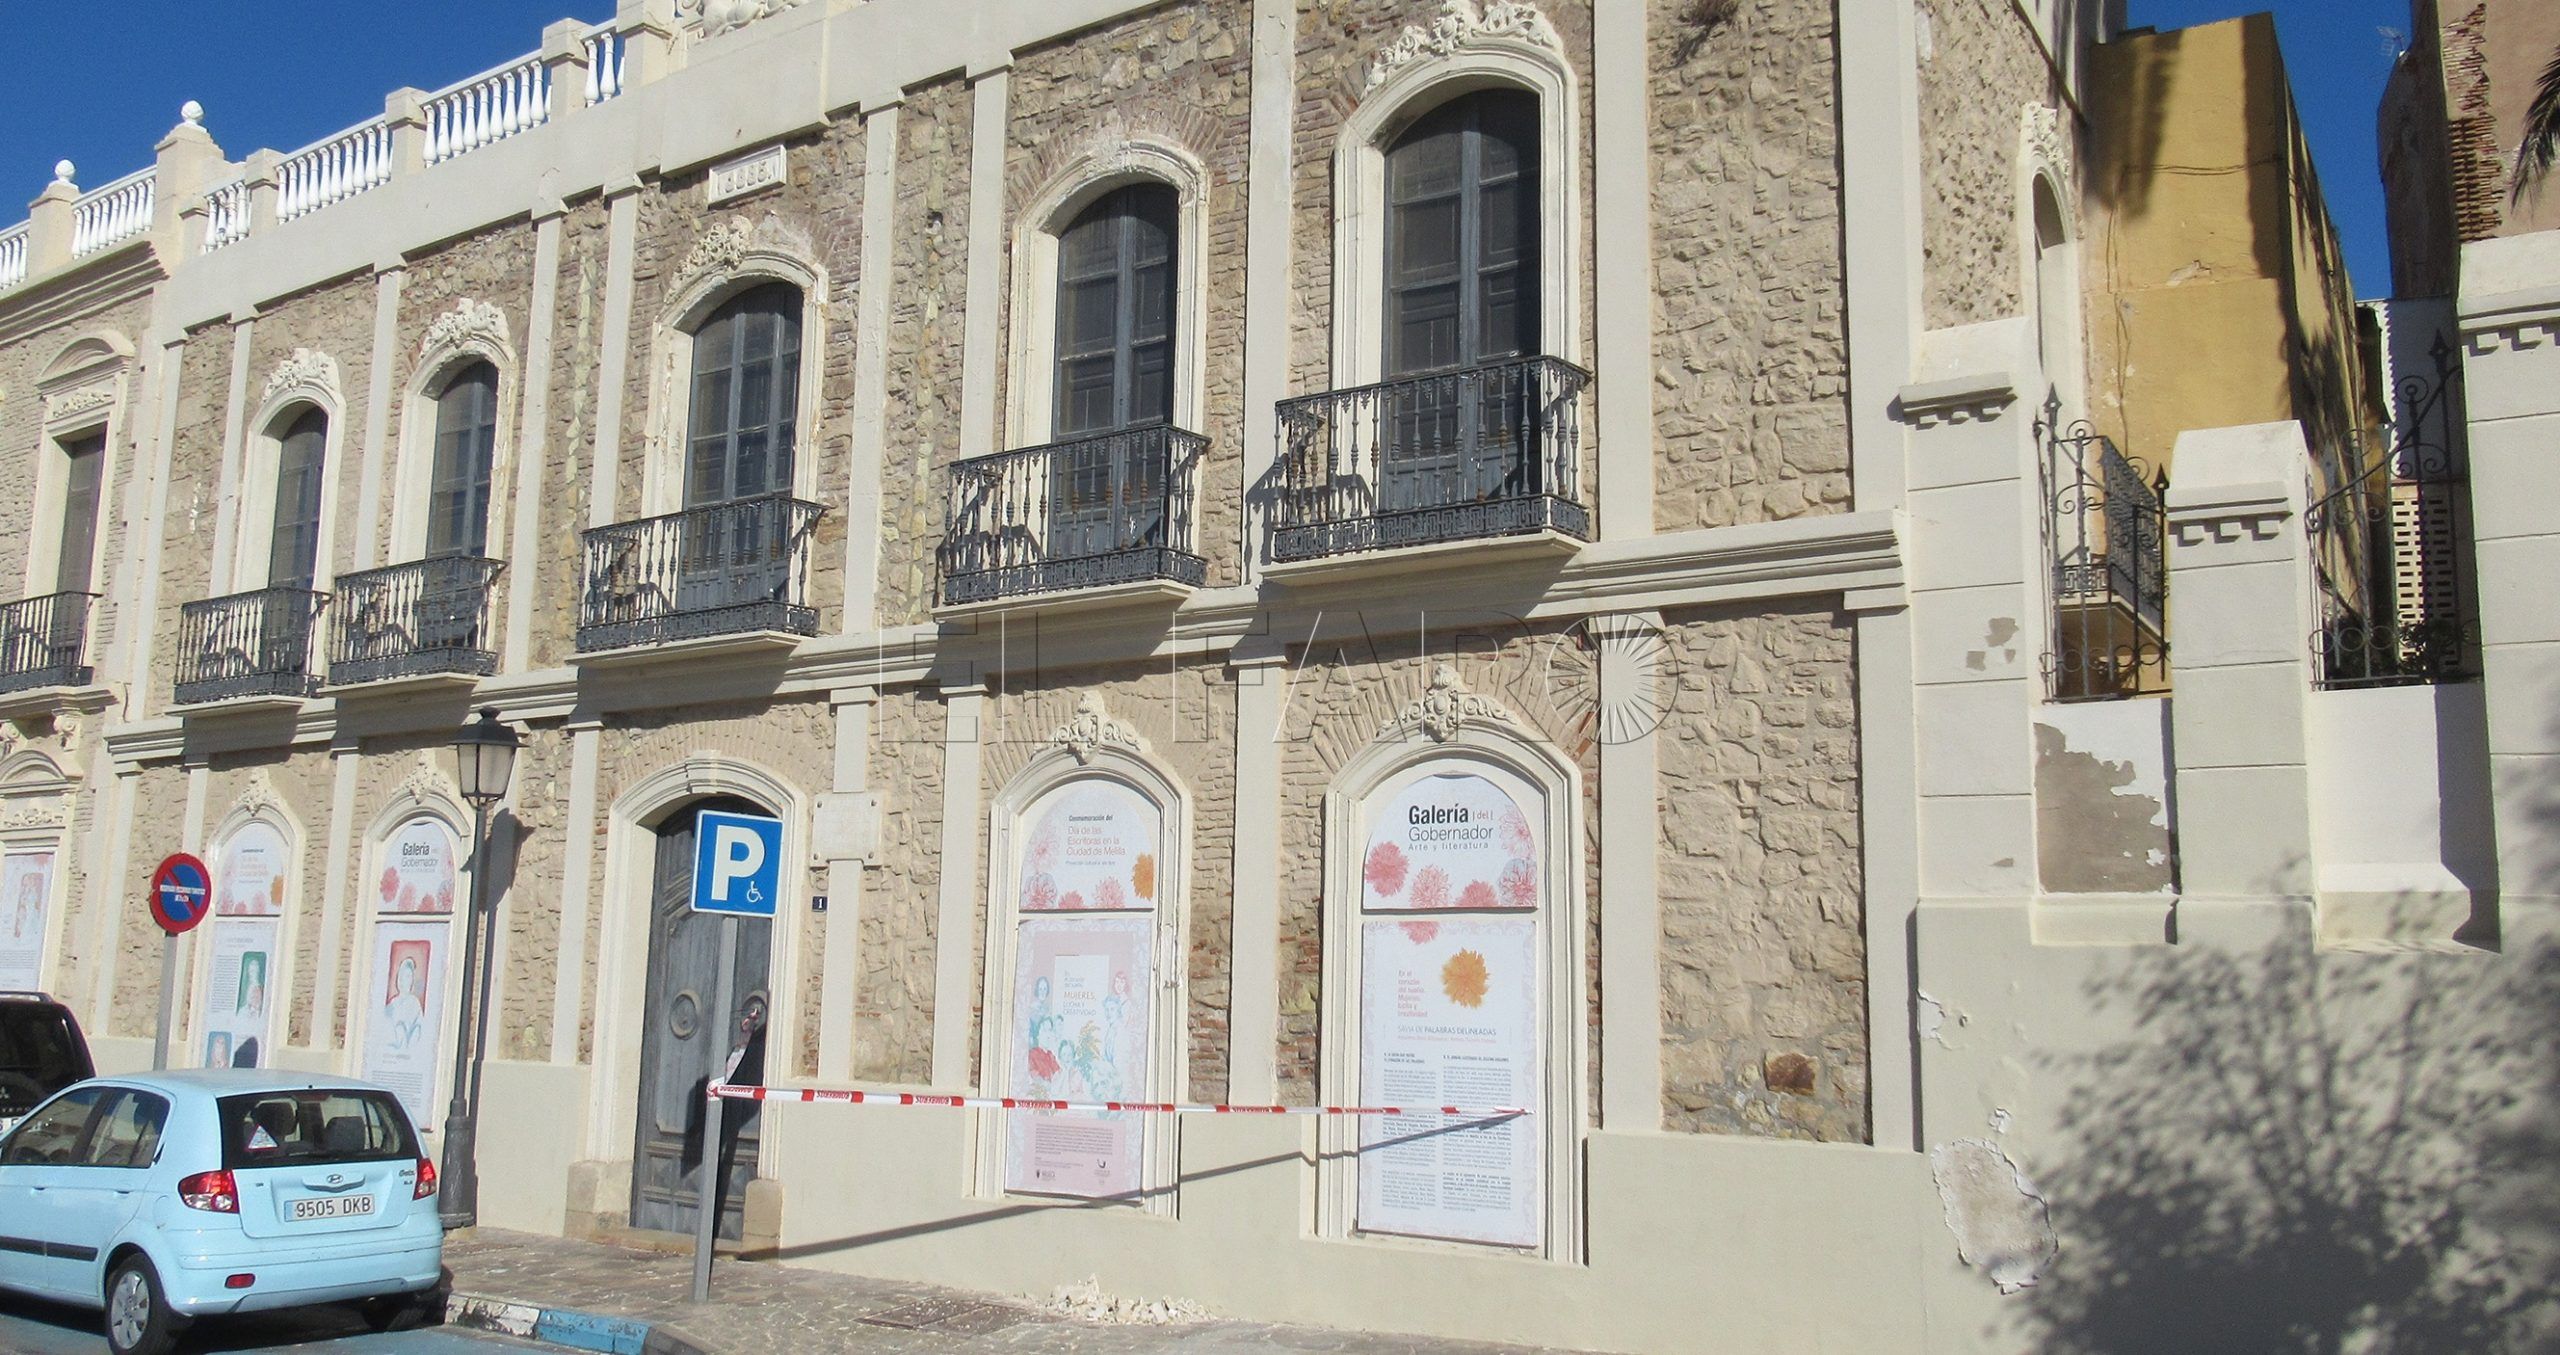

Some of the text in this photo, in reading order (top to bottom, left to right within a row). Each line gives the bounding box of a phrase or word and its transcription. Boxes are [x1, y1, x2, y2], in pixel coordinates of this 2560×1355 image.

[1408, 802, 1469, 825] Galería
[1408, 824, 1494, 842] Gobernador
[402, 842, 430, 856] Galería
[1408, 843, 1428, 851] Arte
[1441, 842, 1489, 850] literatura
[711, 824, 765, 901] P
[817, 898, 823, 909] 1
[296, 1197, 371, 1218] 9505 DKB
